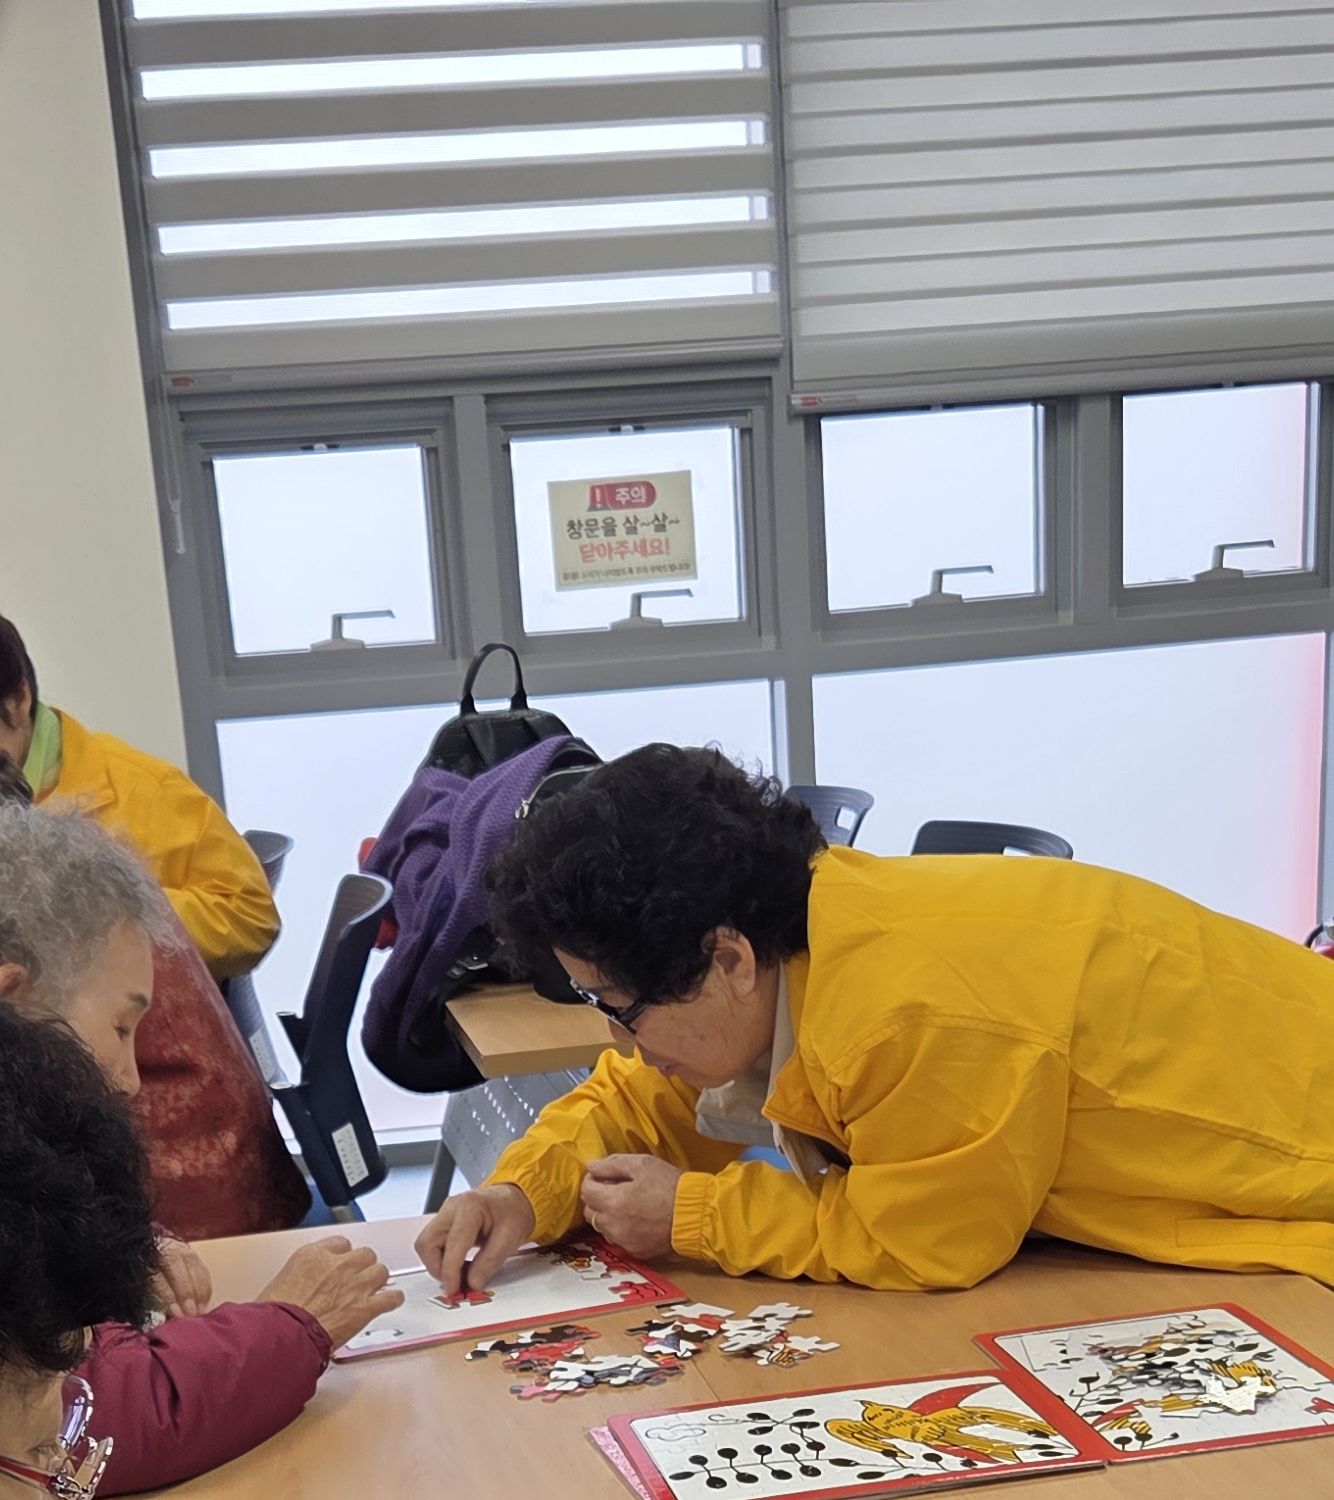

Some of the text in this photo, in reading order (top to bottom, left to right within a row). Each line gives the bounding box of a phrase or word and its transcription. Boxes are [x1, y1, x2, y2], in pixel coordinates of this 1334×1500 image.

[615, 485, 647, 506] 주의
[566, 516, 618, 541] 창문을
[578, 537, 671, 564] 닫아주세요!
